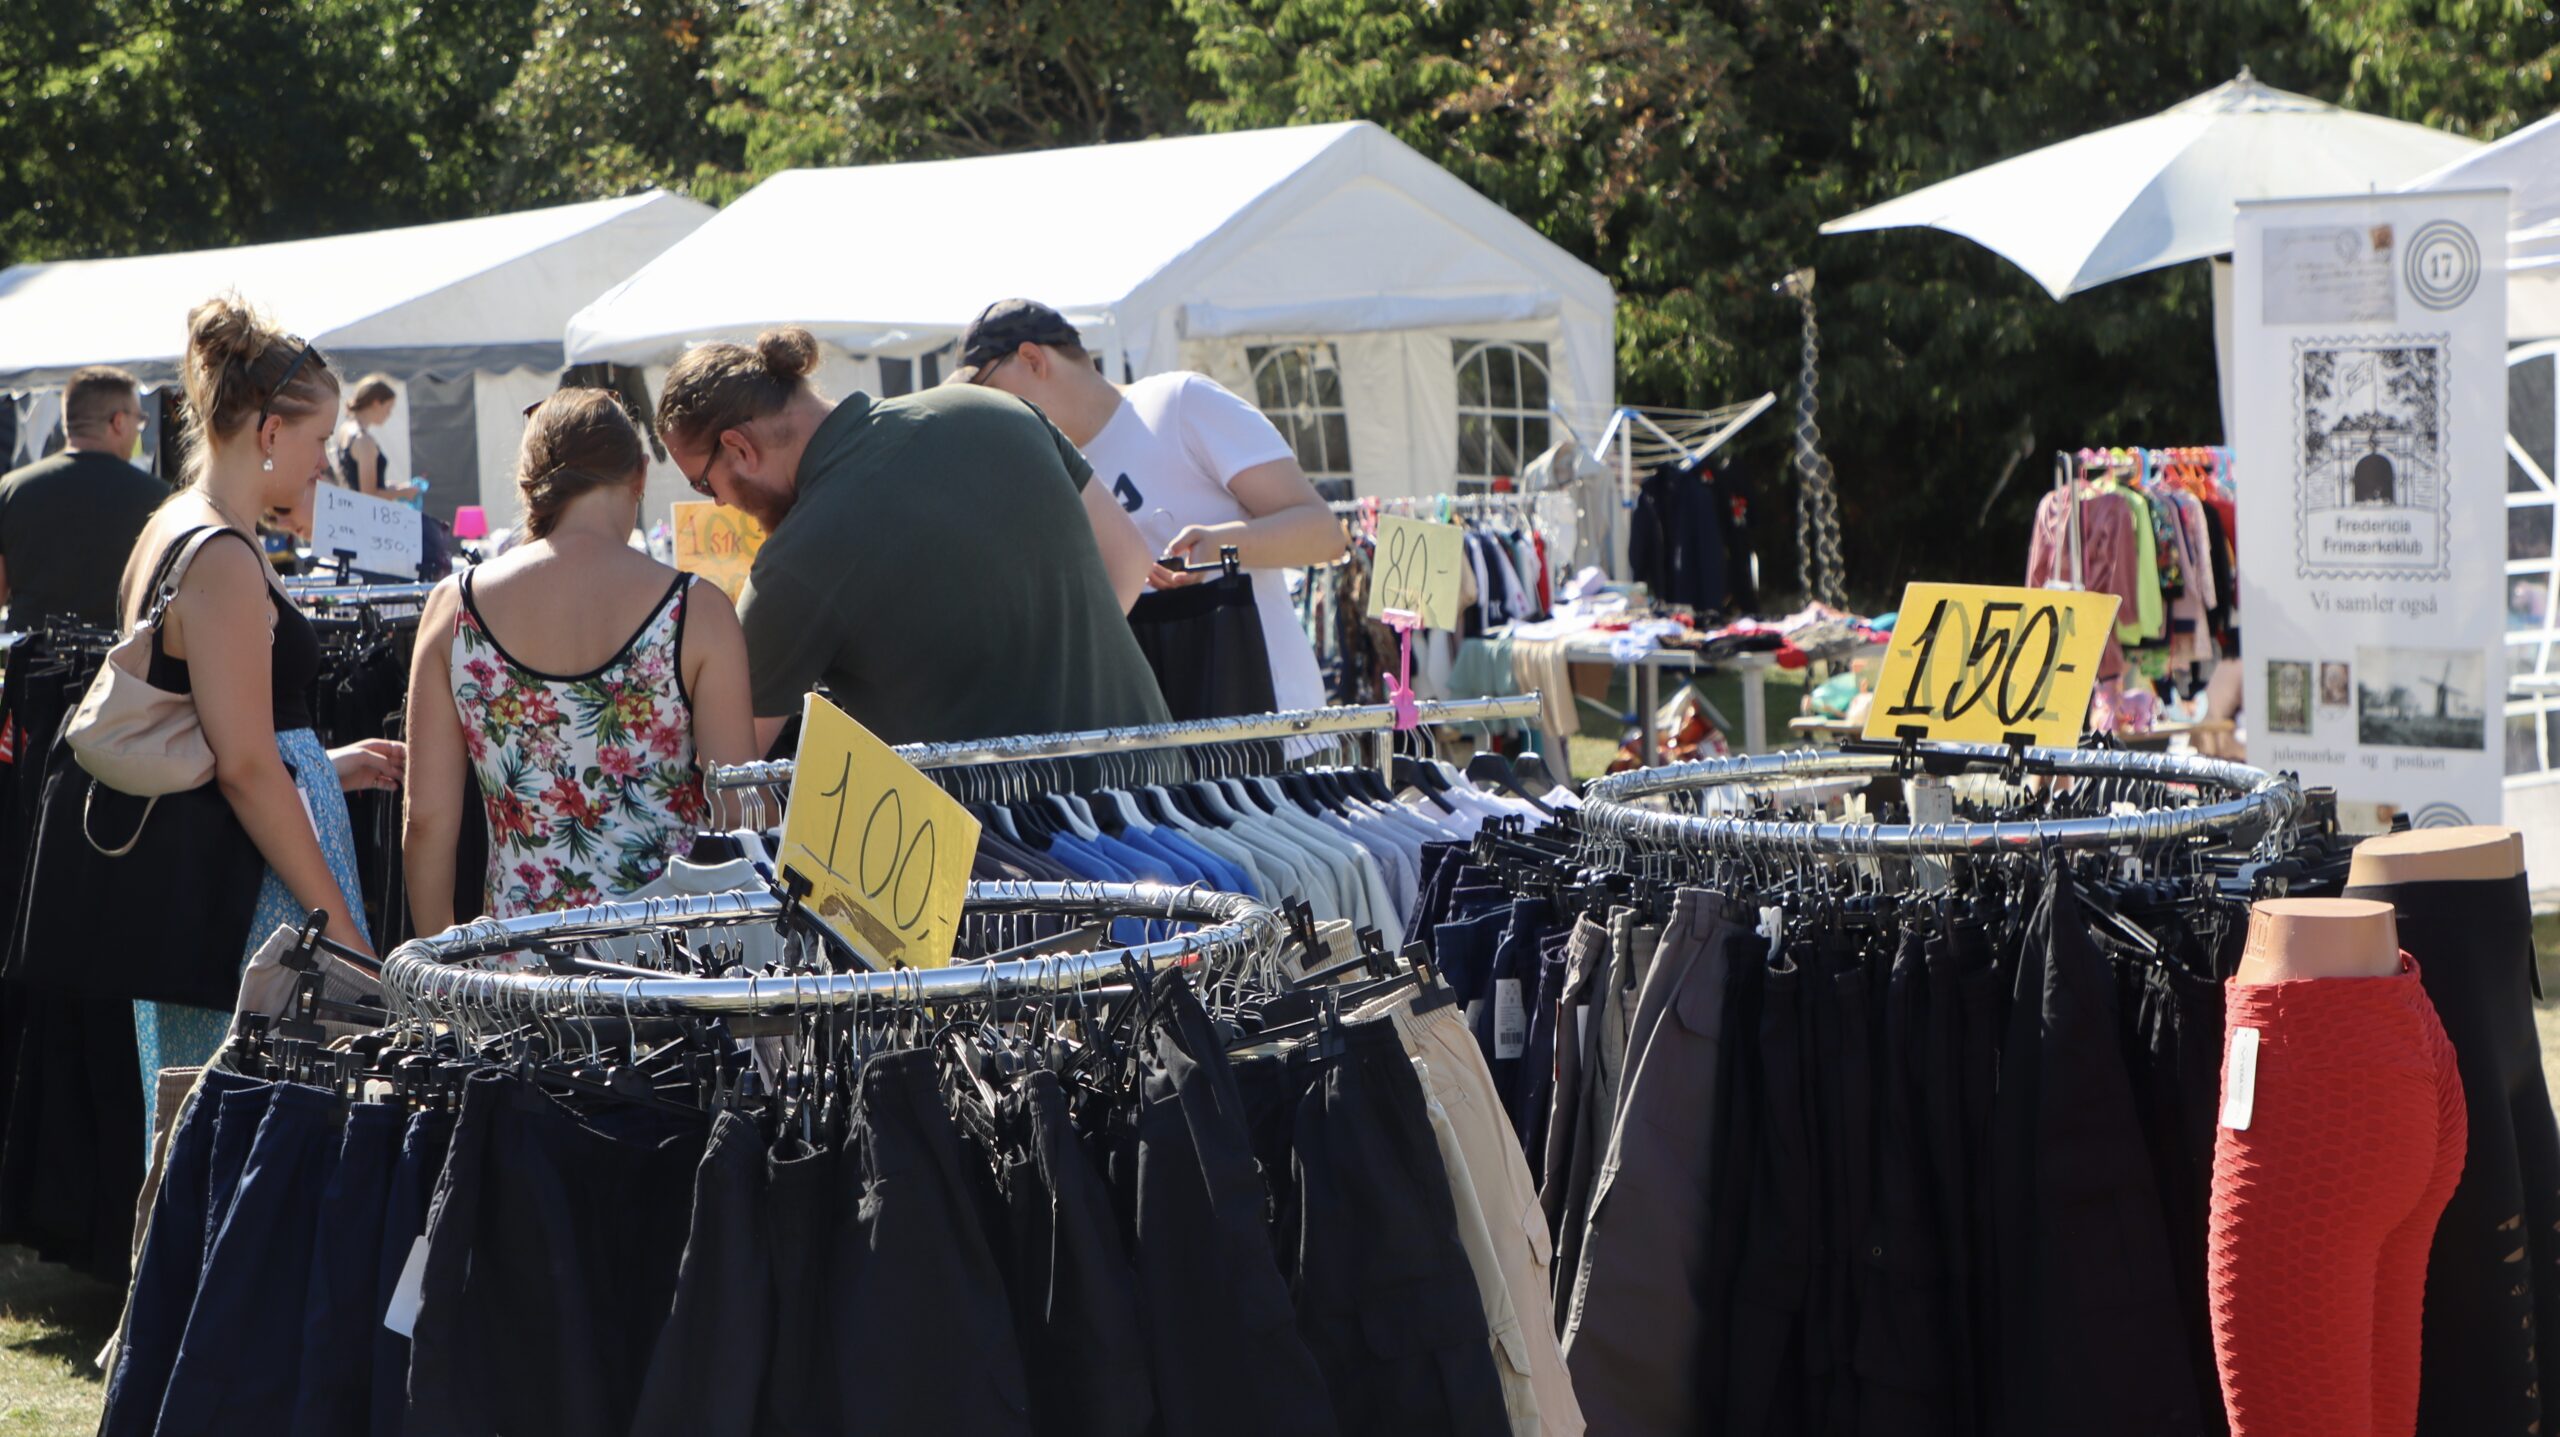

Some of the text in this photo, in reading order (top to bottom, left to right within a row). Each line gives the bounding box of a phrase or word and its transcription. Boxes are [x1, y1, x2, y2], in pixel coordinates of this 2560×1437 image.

[2431, 253, 2453, 279] 17
[327, 492, 336, 510] 1
[327, 524, 338, 540] 2
[2336, 516, 2412, 534] Fredericia
[2323, 537, 2424, 556] Frimærkeklub
[2310, 591, 2438, 620] Vi samler også
[2272, 746, 2446, 771] julemærker og postkort
